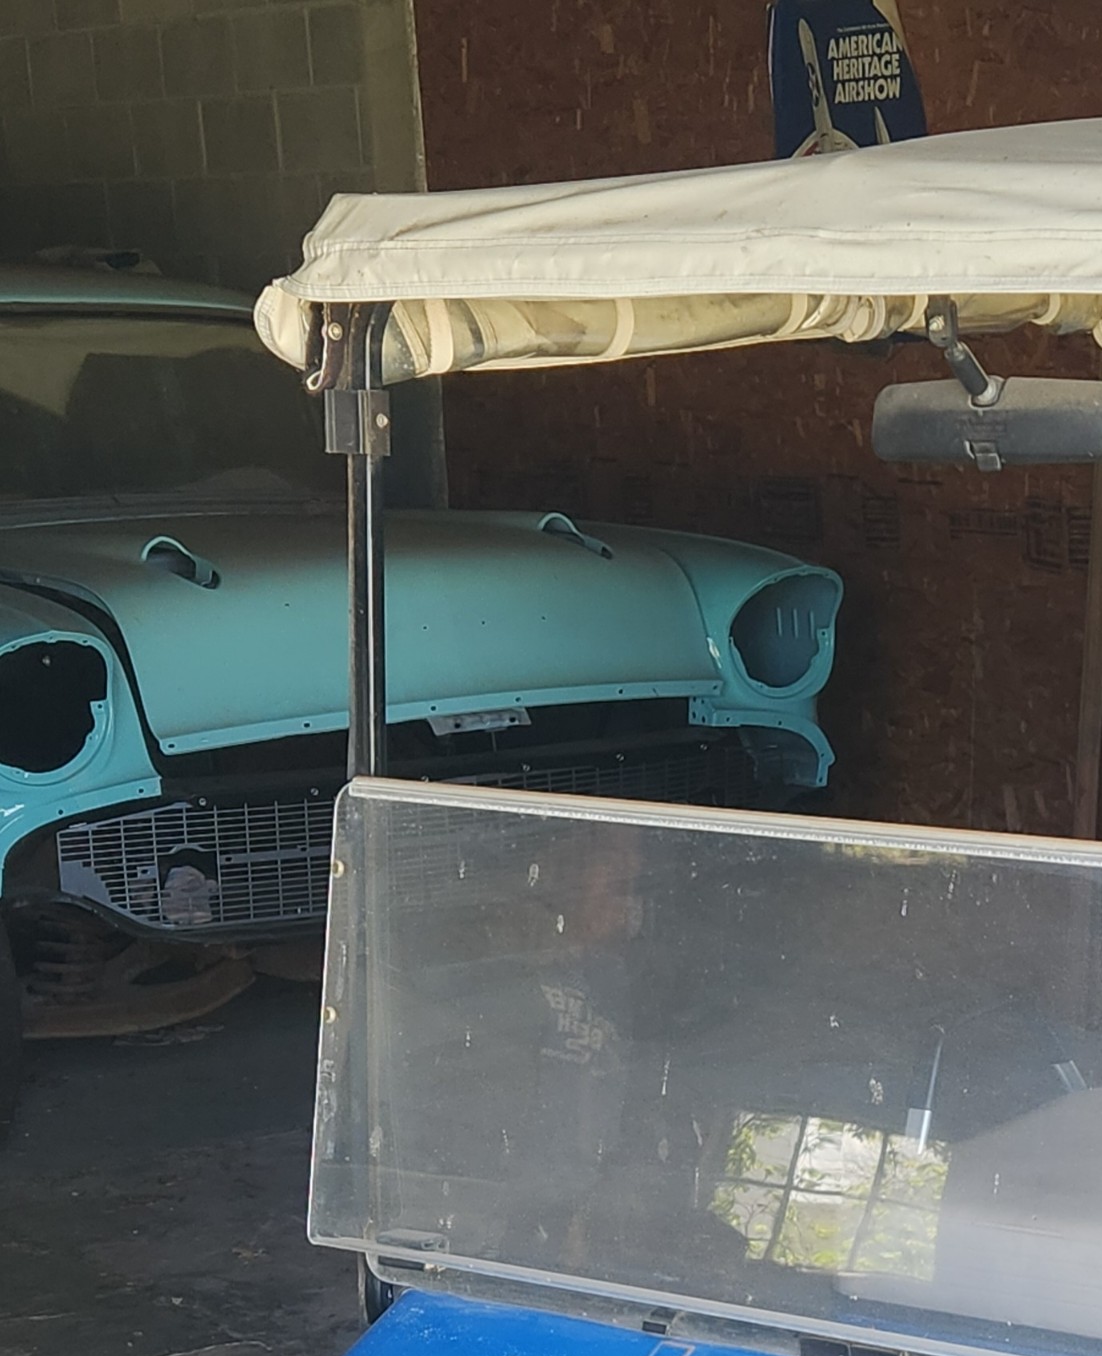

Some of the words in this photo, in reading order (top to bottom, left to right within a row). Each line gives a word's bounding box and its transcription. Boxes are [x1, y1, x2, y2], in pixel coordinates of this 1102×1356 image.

[827, 32, 903, 60] AMERICAN
[833, 53, 900, 81] HERITAGE
[834, 76, 900, 104] AIRSHOW
